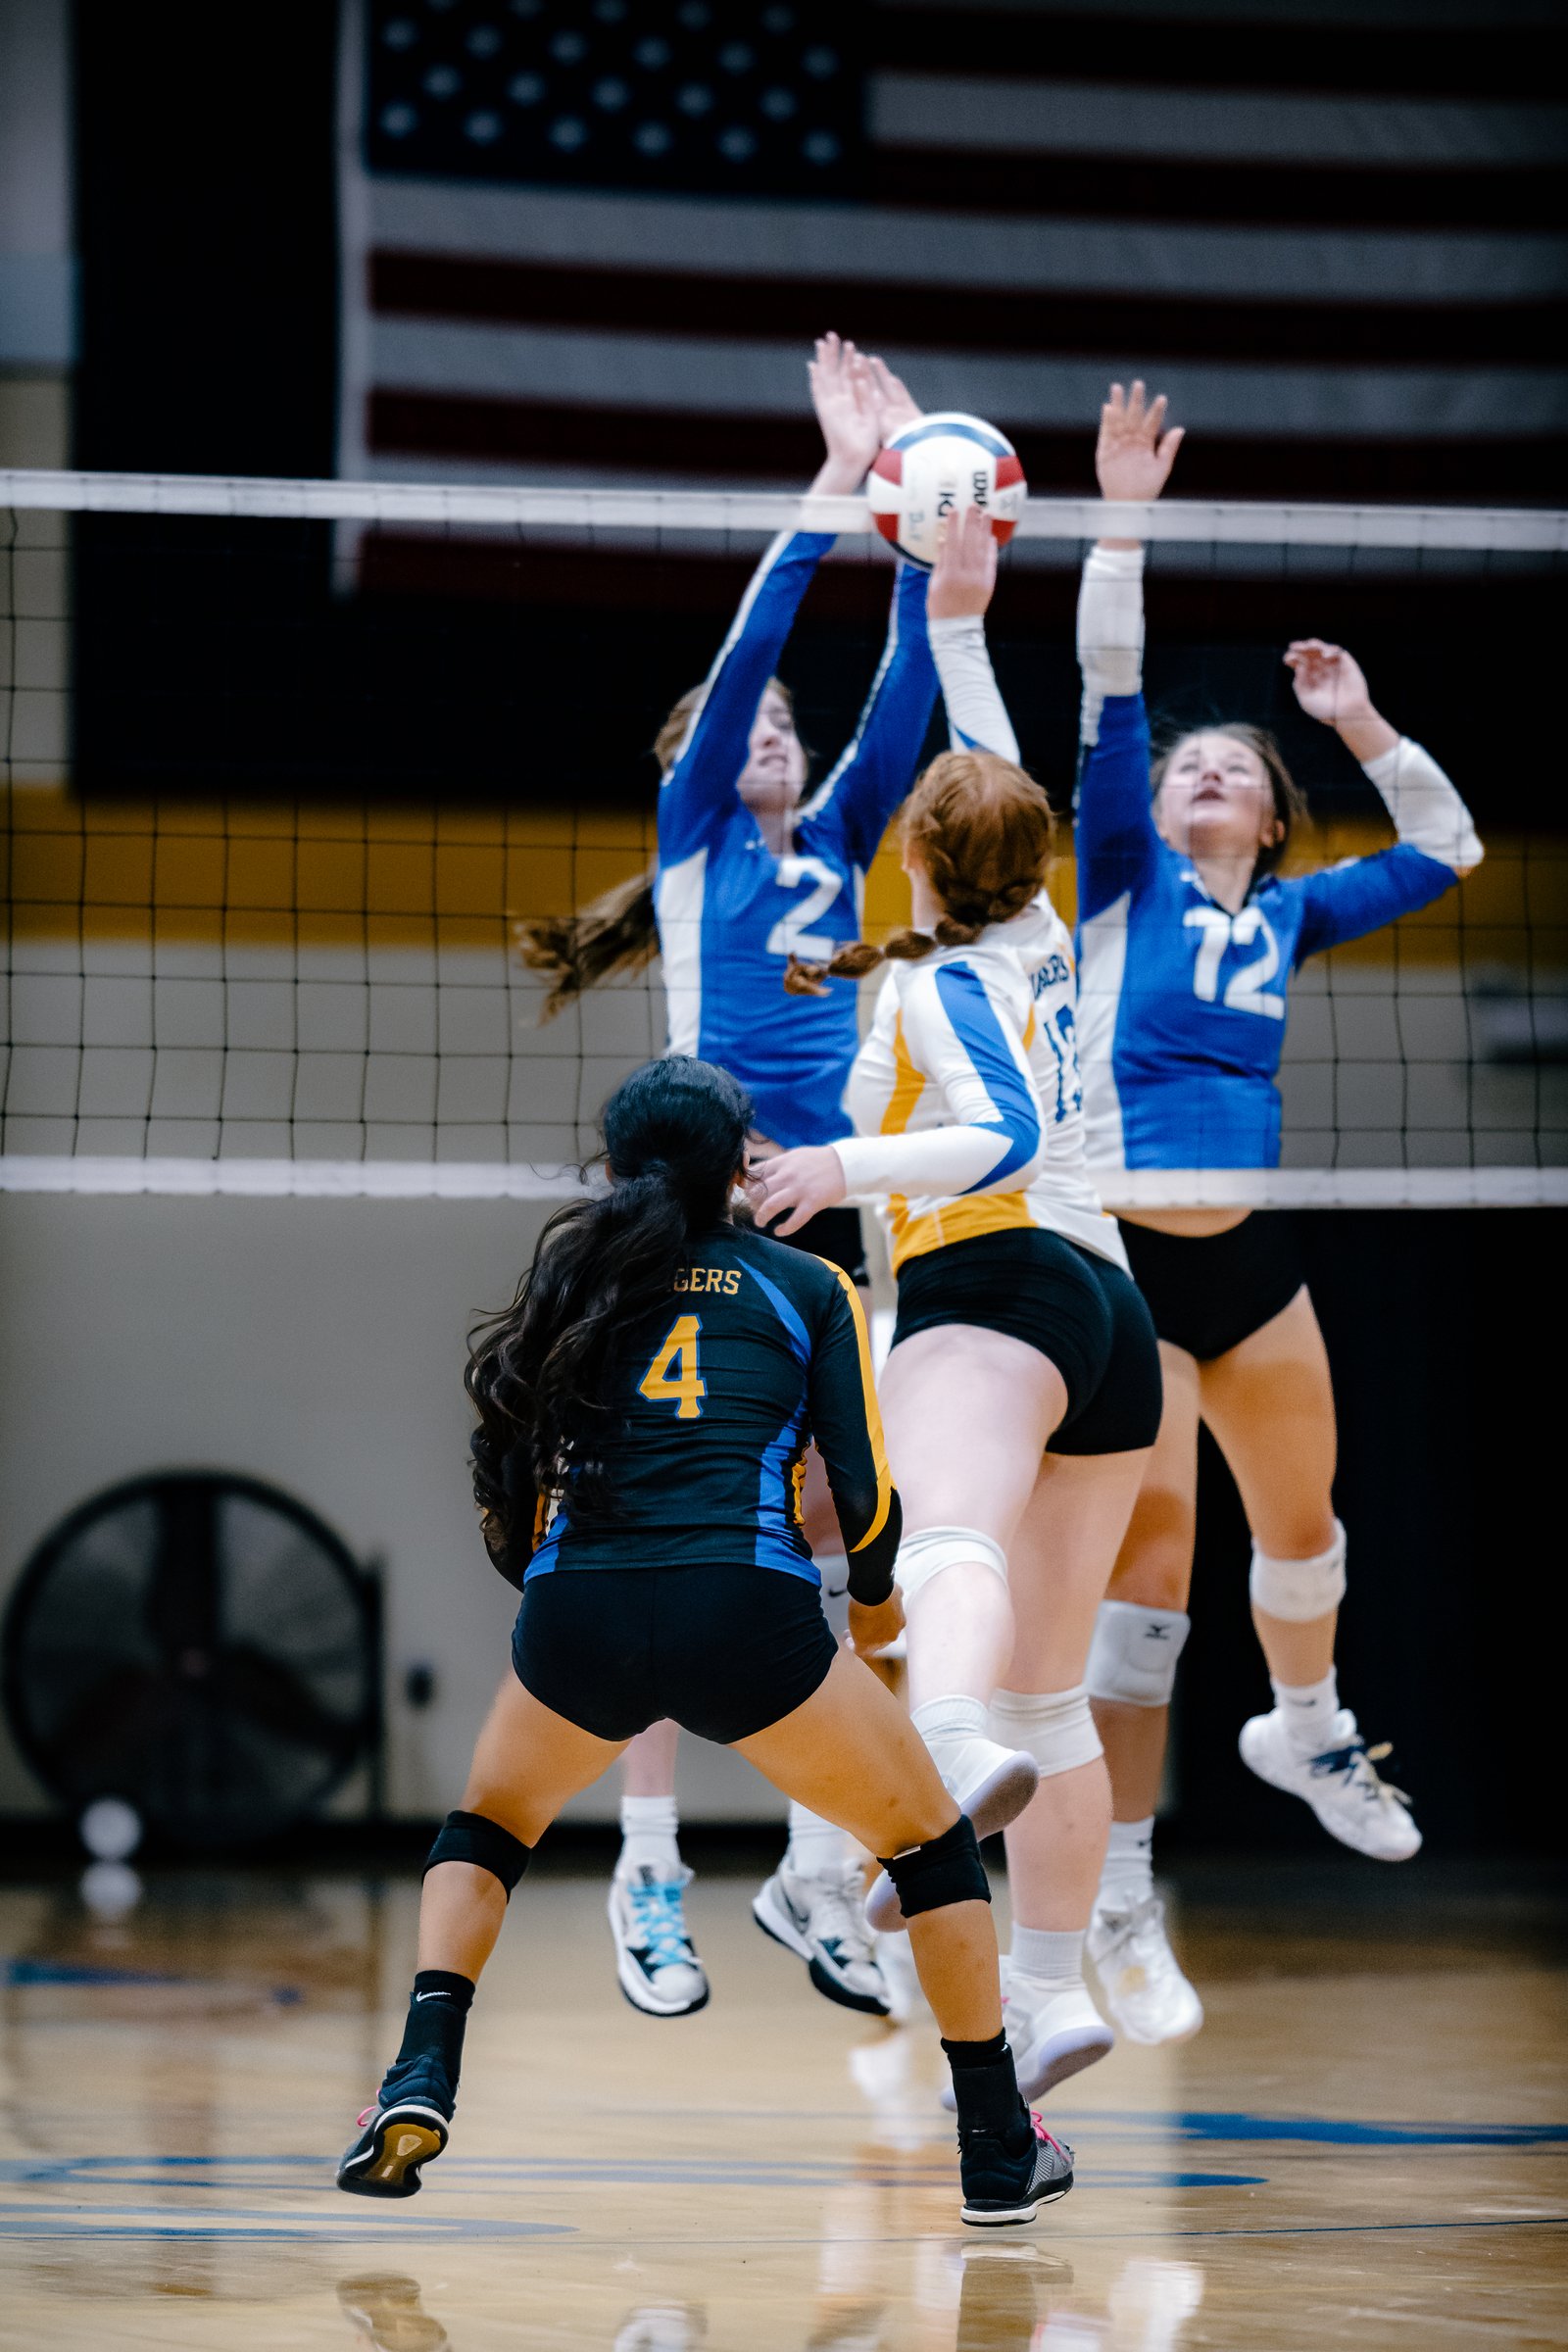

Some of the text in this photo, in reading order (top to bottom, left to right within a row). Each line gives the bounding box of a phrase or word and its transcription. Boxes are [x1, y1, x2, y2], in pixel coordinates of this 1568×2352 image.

[766, 856, 843, 960] 2
[669, 1267, 742, 1296] GERS
[637, 1313, 709, 1420] 4
